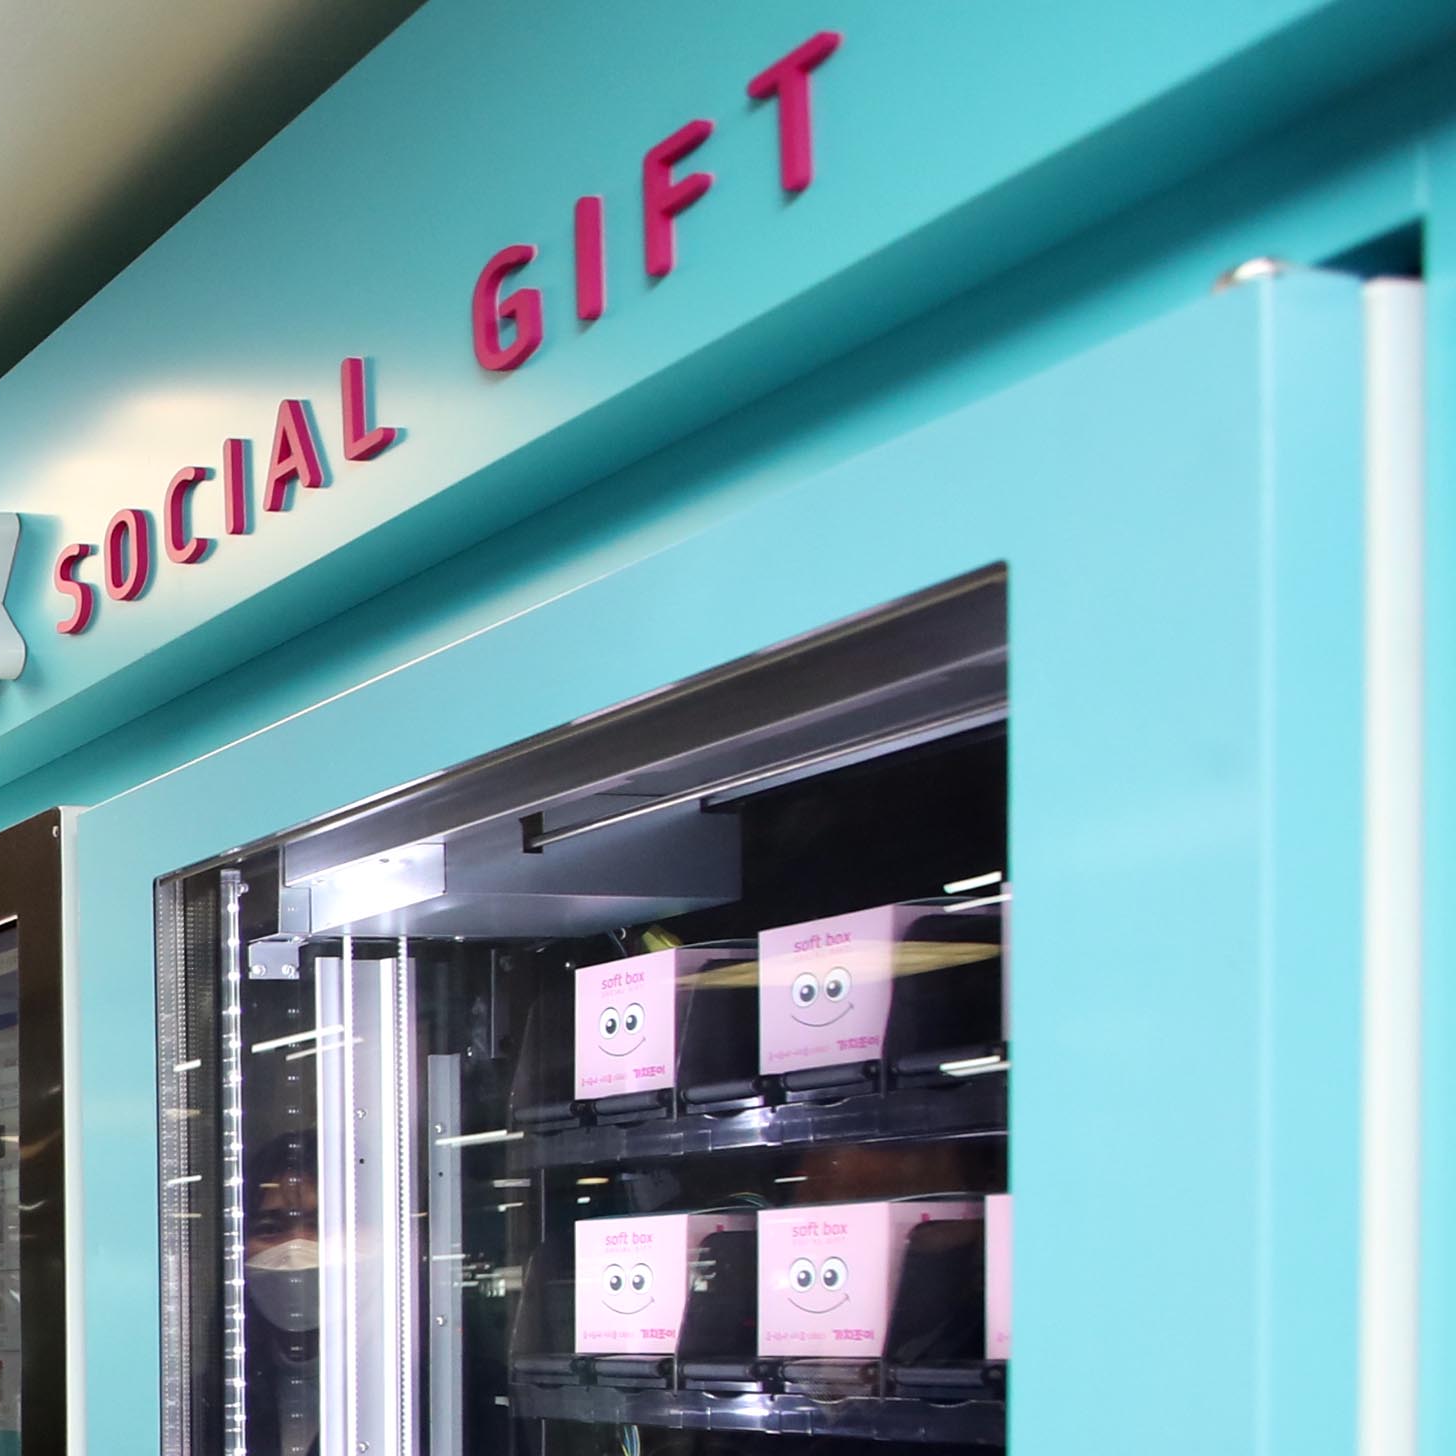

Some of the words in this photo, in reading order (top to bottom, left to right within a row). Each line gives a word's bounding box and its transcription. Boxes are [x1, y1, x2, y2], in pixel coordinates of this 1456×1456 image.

[52, 355, 398, 635] SOCIAL
[470, 30, 842, 372] GIFT
[793, 934, 821, 953] soft
[826, 931, 852, 948] box
[601, 973, 623, 990] soft
[625, 971, 645, 985] box
[605, 1231, 629, 1246] soft
[632, 1232, 653, 1245] box
[792, 1221, 819, 1237] soft
[823, 1221, 849, 1236] box
